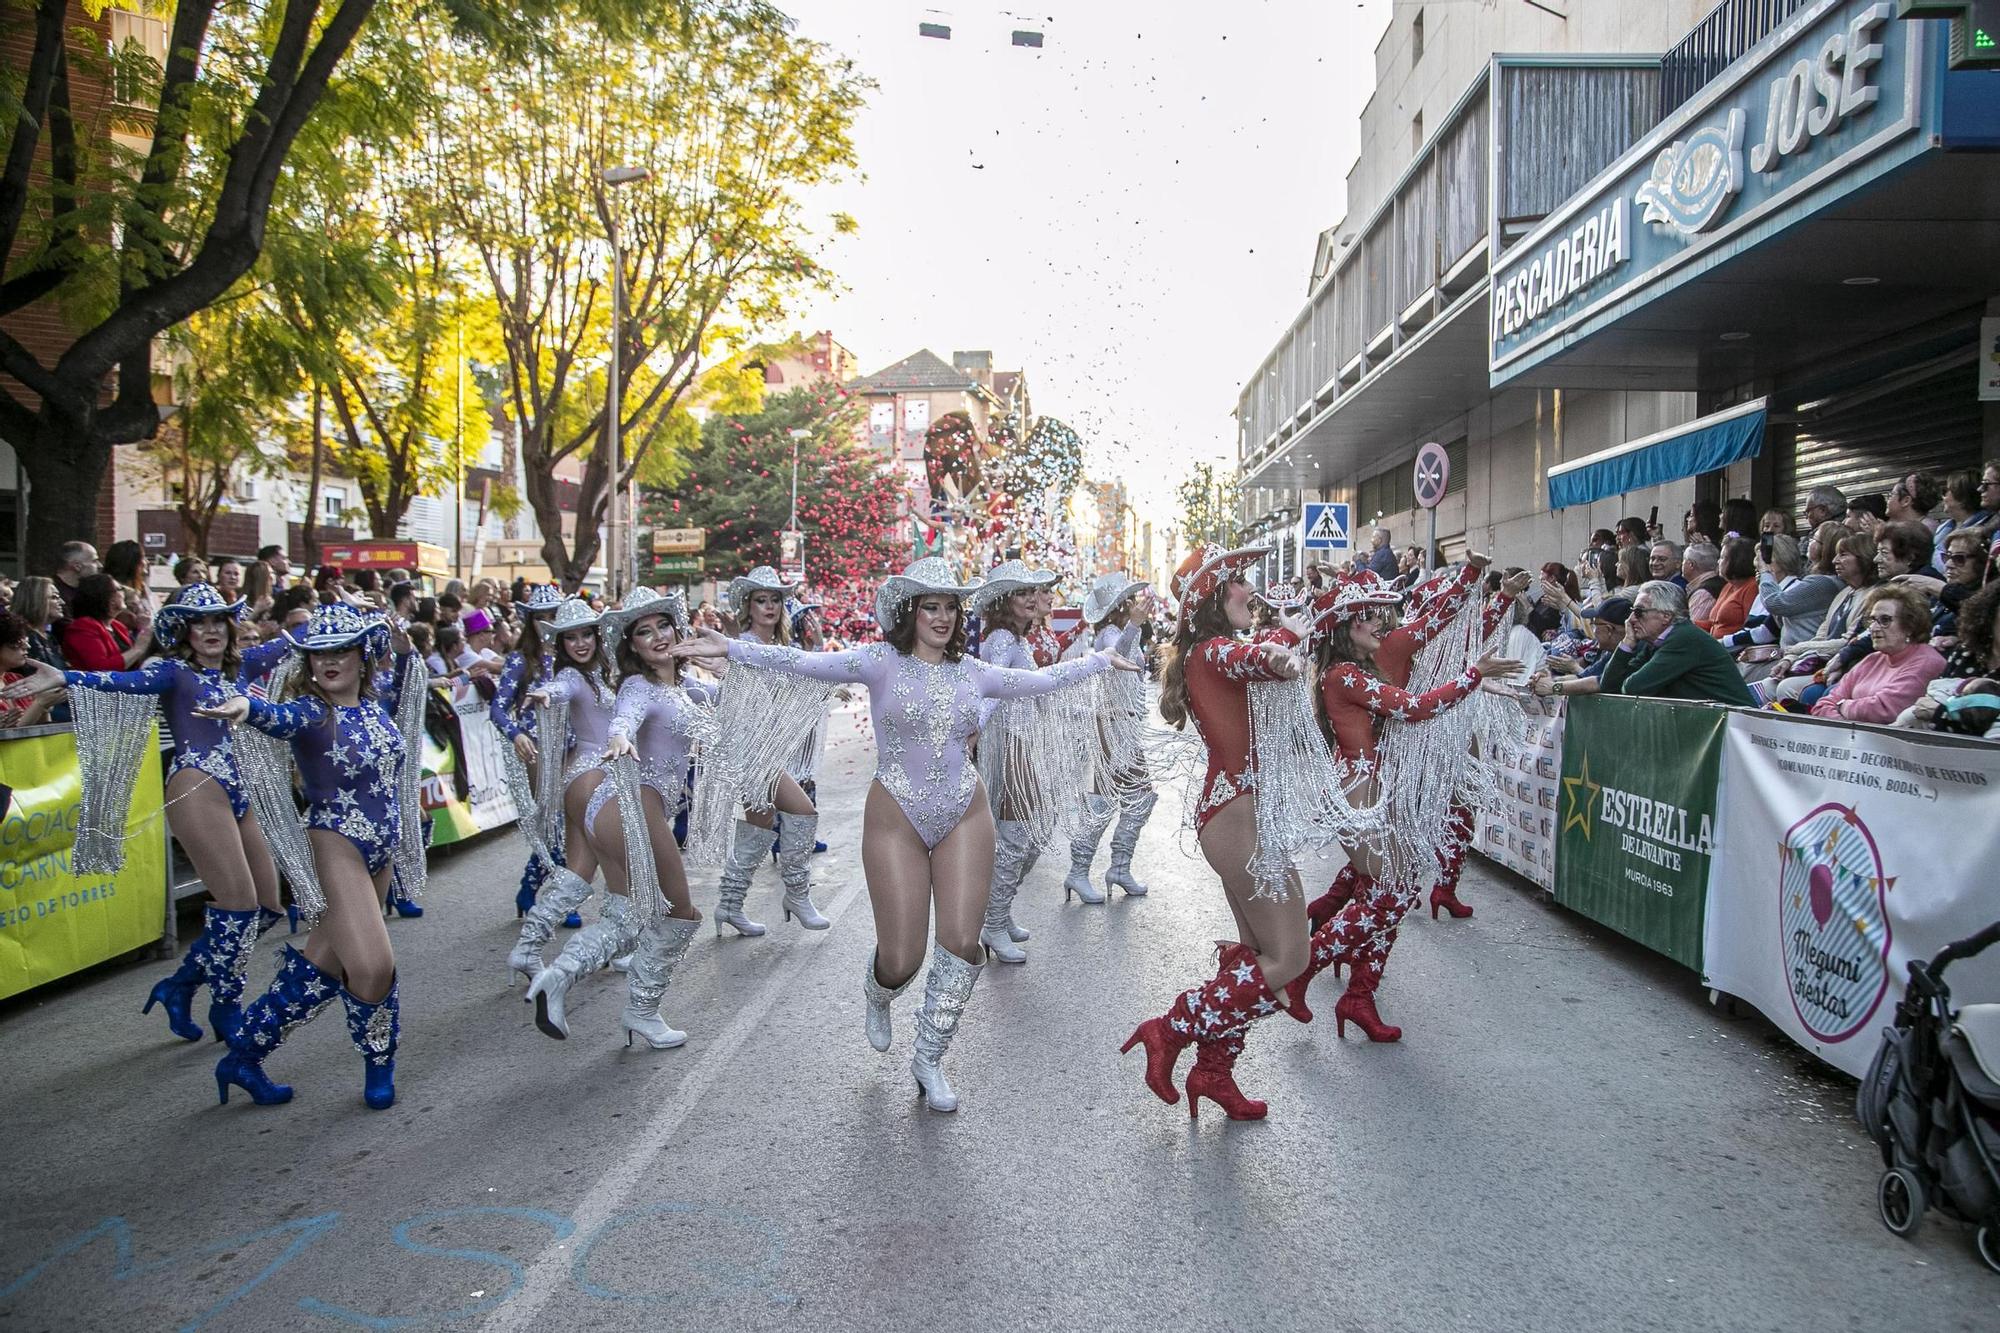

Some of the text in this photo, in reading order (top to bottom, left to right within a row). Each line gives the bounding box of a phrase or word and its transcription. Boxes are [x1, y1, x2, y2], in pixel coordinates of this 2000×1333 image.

[1750, 2, 1890, 173] JOSE
[1493, 197, 1630, 343] PESCADERIA
[1786, 741, 1817, 758] GLOBOS
[1818, 746, 1828, 759] DE
[1830, 748, 1850, 762] HELIO
[1861, 752, 1925, 777] DECORACIONES
[1926, 765, 1938, 781] DE
[1940, 768, 1988, 786] EVENTOS
[1886, 778, 1921, 799] BODAS,
[1600, 786, 1713, 857] ESTRELLA
[1621, 833, 1681, 872] DE LEVANTE
[36, 898, 58, 917] DE
[61, 882, 116, 910] TORRES
[1624, 867, 1673, 897] MURCIA 1963
[1793, 928, 1862, 983] Megumi
[1795, 967, 1852, 1020] Fiestas
